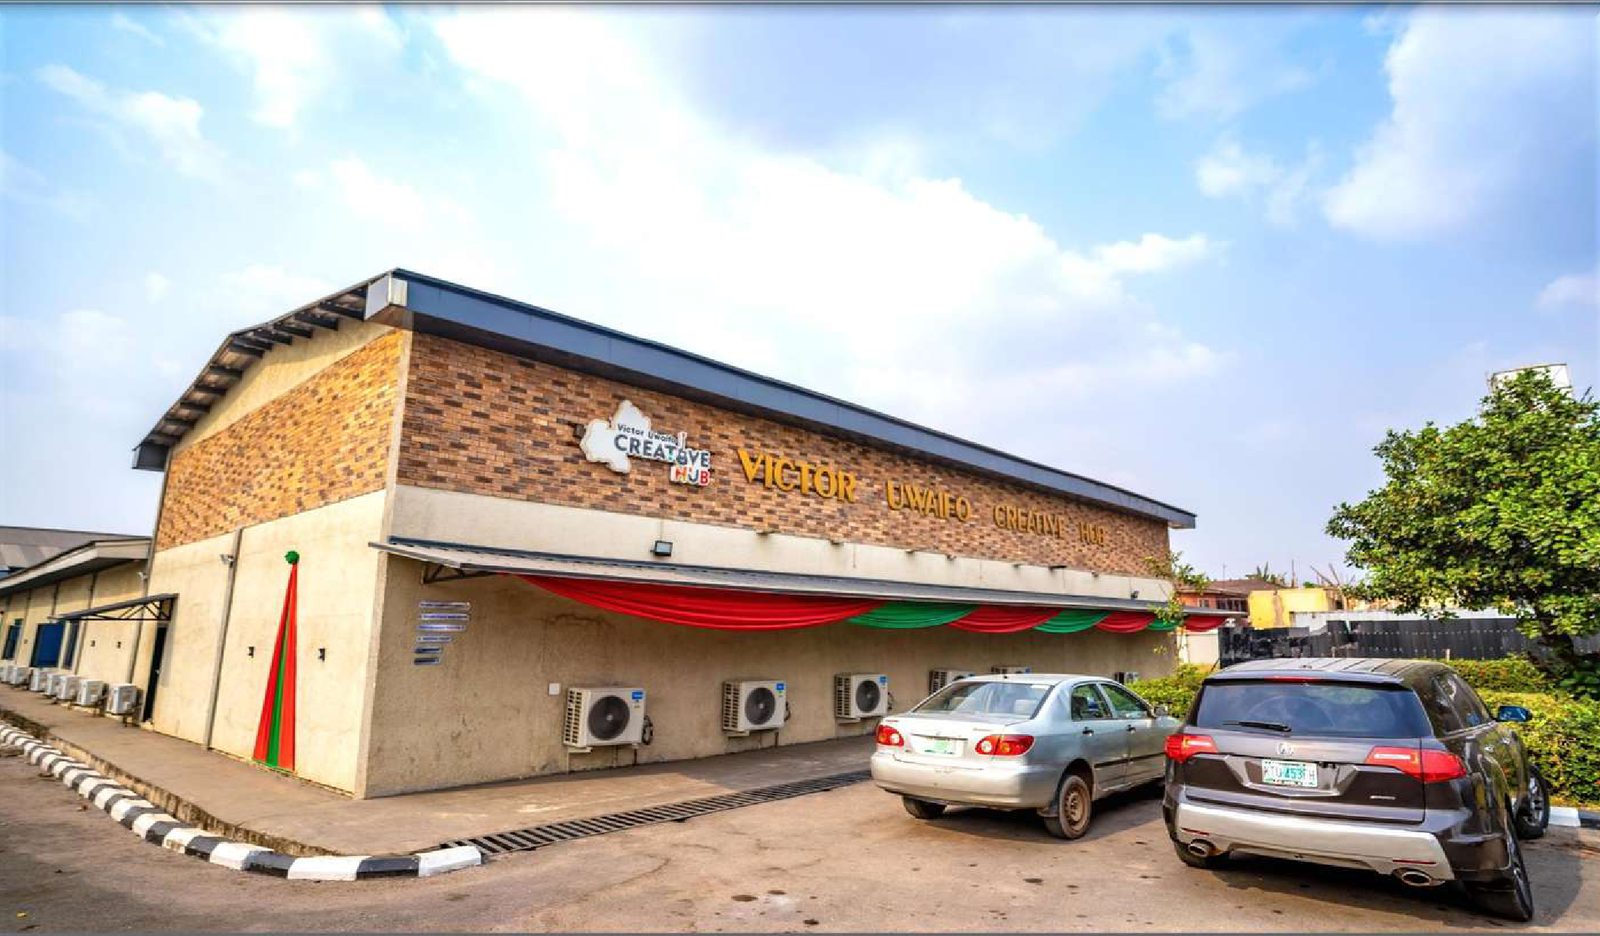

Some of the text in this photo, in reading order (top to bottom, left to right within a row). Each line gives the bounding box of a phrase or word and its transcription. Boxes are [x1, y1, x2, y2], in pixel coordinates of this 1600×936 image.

[617, 423, 644, 437] Victor
[675, 467, 710, 485] HUB
[737, 447, 857, 503] VICTOR
[885, 479, 972, 522] UWAIFO
[992, 504, 1066, 541] CREATIVE
